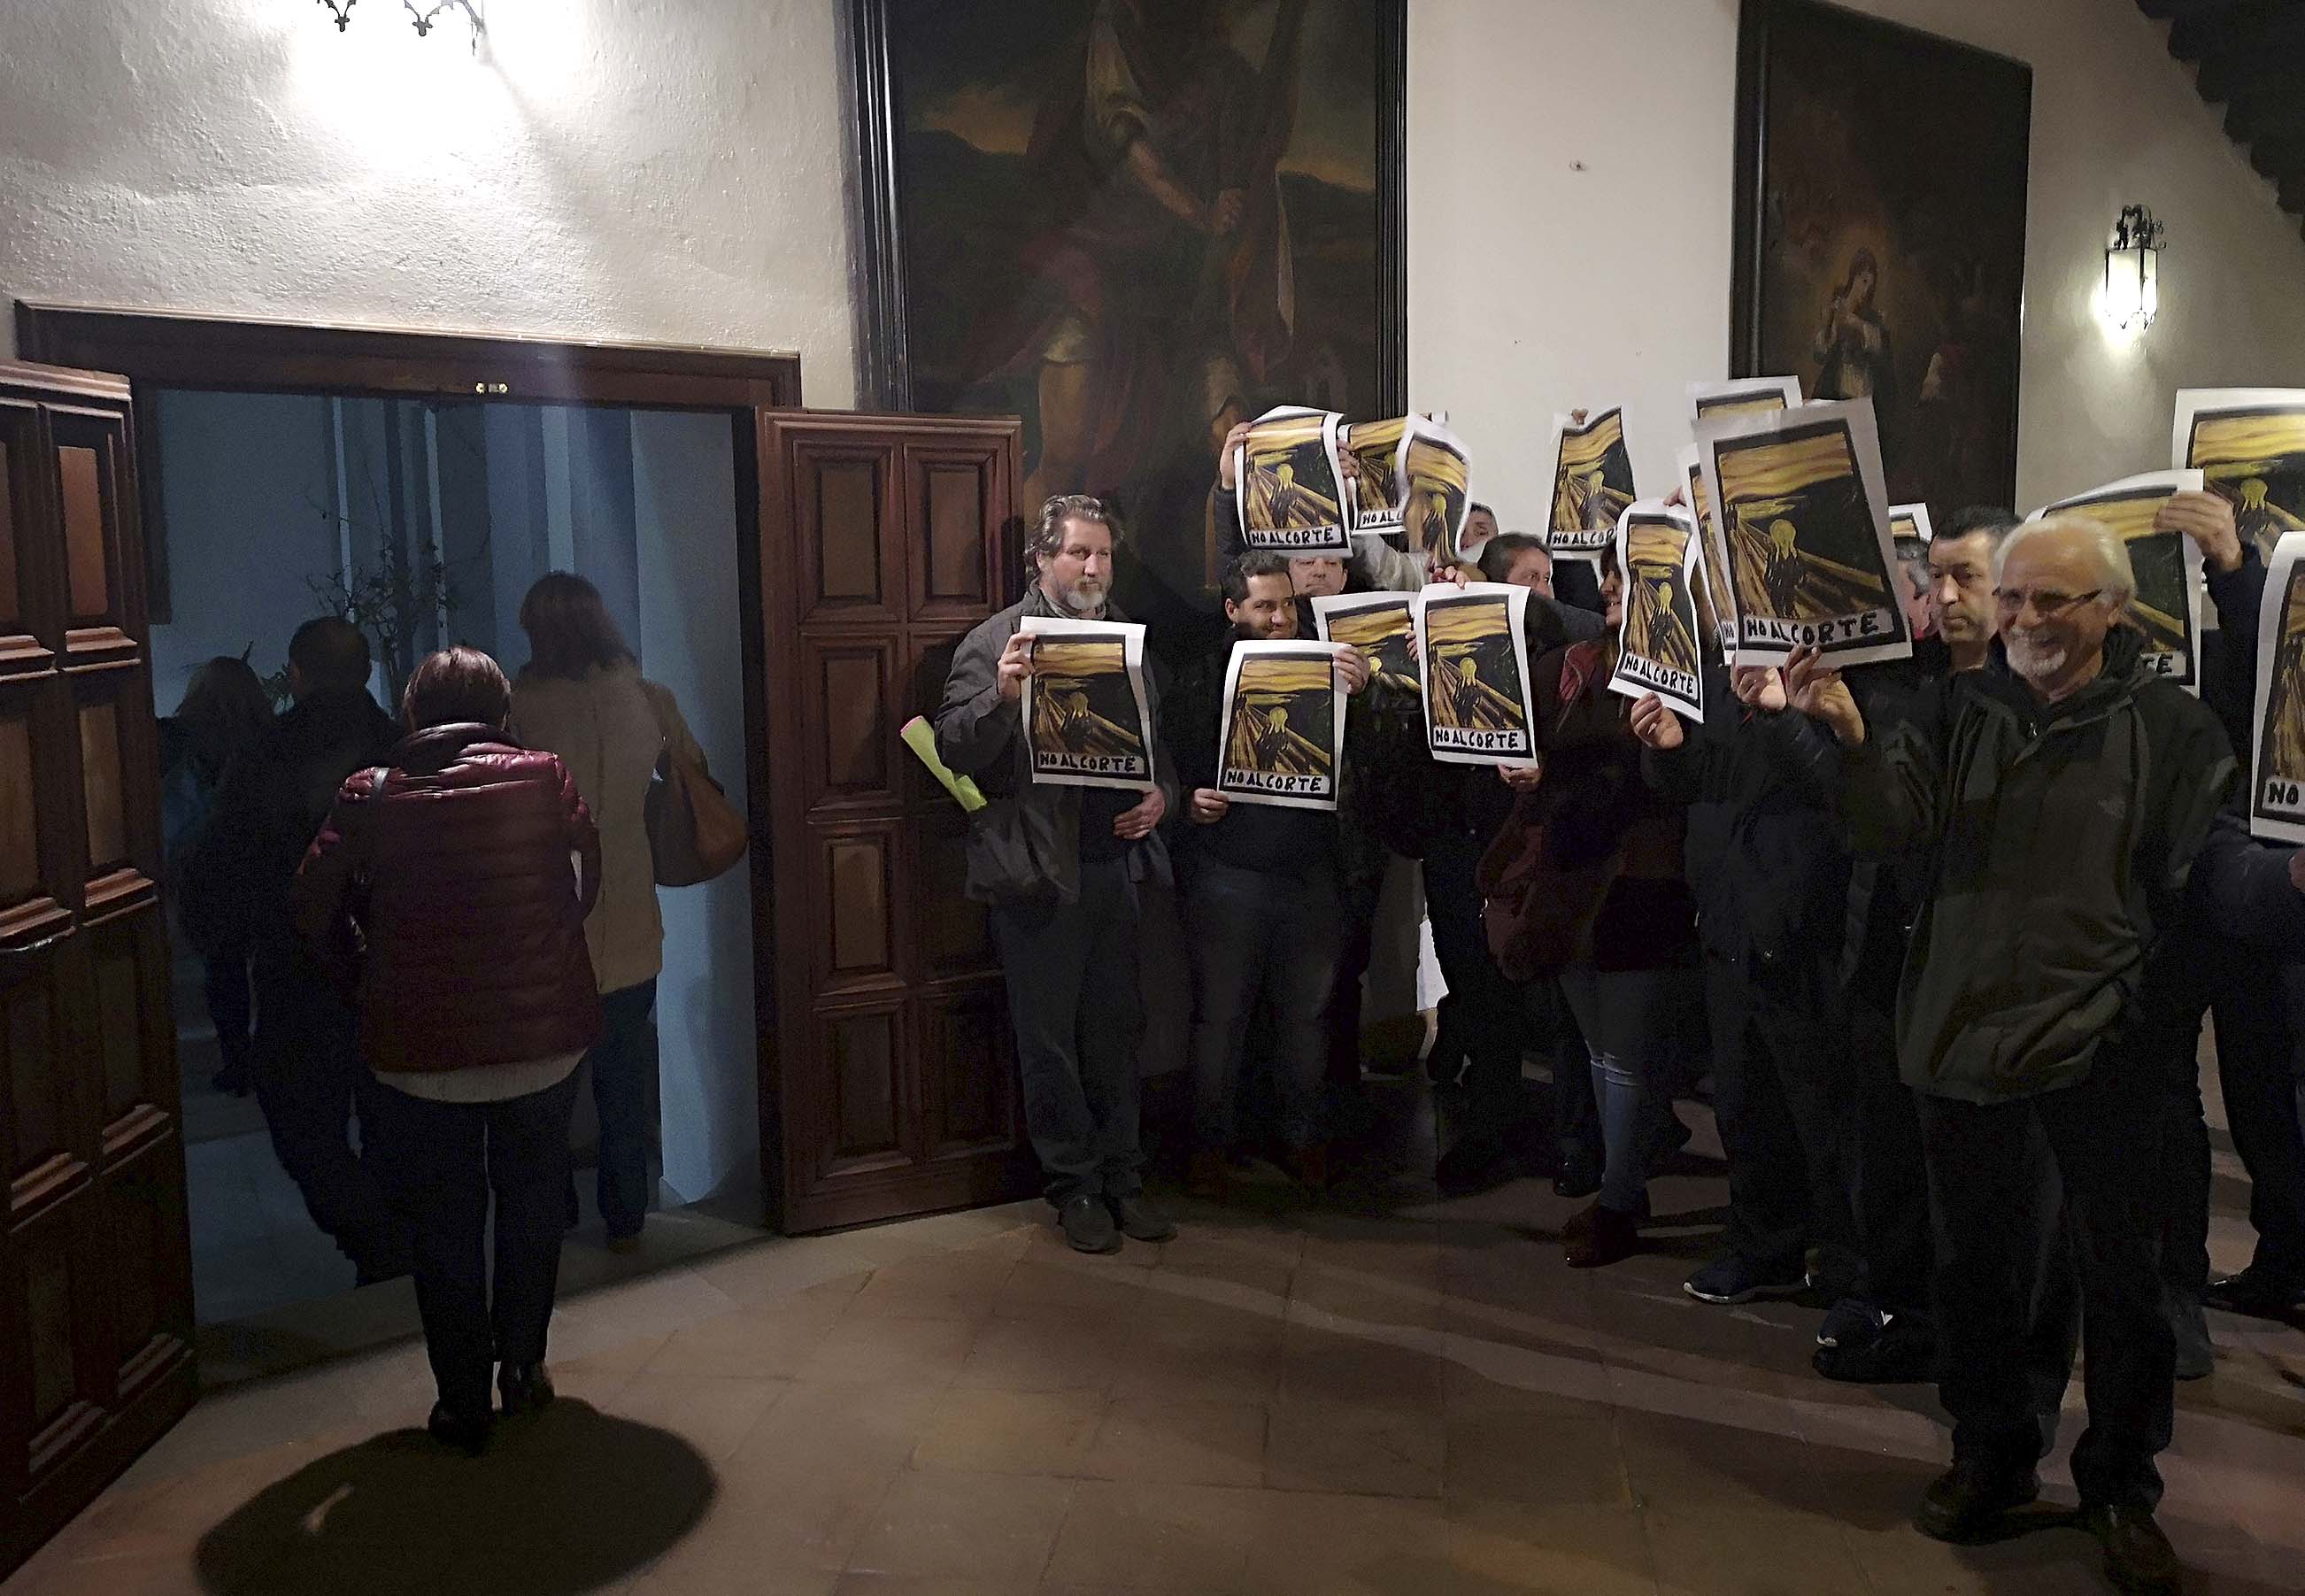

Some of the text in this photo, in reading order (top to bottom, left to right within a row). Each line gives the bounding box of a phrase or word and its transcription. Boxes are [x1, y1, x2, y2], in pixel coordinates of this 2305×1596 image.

[1362, 512, 1376, 524] NO
[1379, 510, 1395, 522] AL
[1251, 527, 1334, 544] NO AL CORTE
[1553, 528, 1615, 545] NO AL COR
[1746, 619, 1767, 636] NO
[1790, 611, 1879, 645] CORTE
[1624, 654, 1693, 694] NO AL CORTE
[1435, 729, 1519, 749] NO AL CORTE
[1039, 753, 1136, 772] NO AL CORTE
[1227, 771, 1322, 792] NO AL CORTE
[2268, 781, 2300, 806] NO
